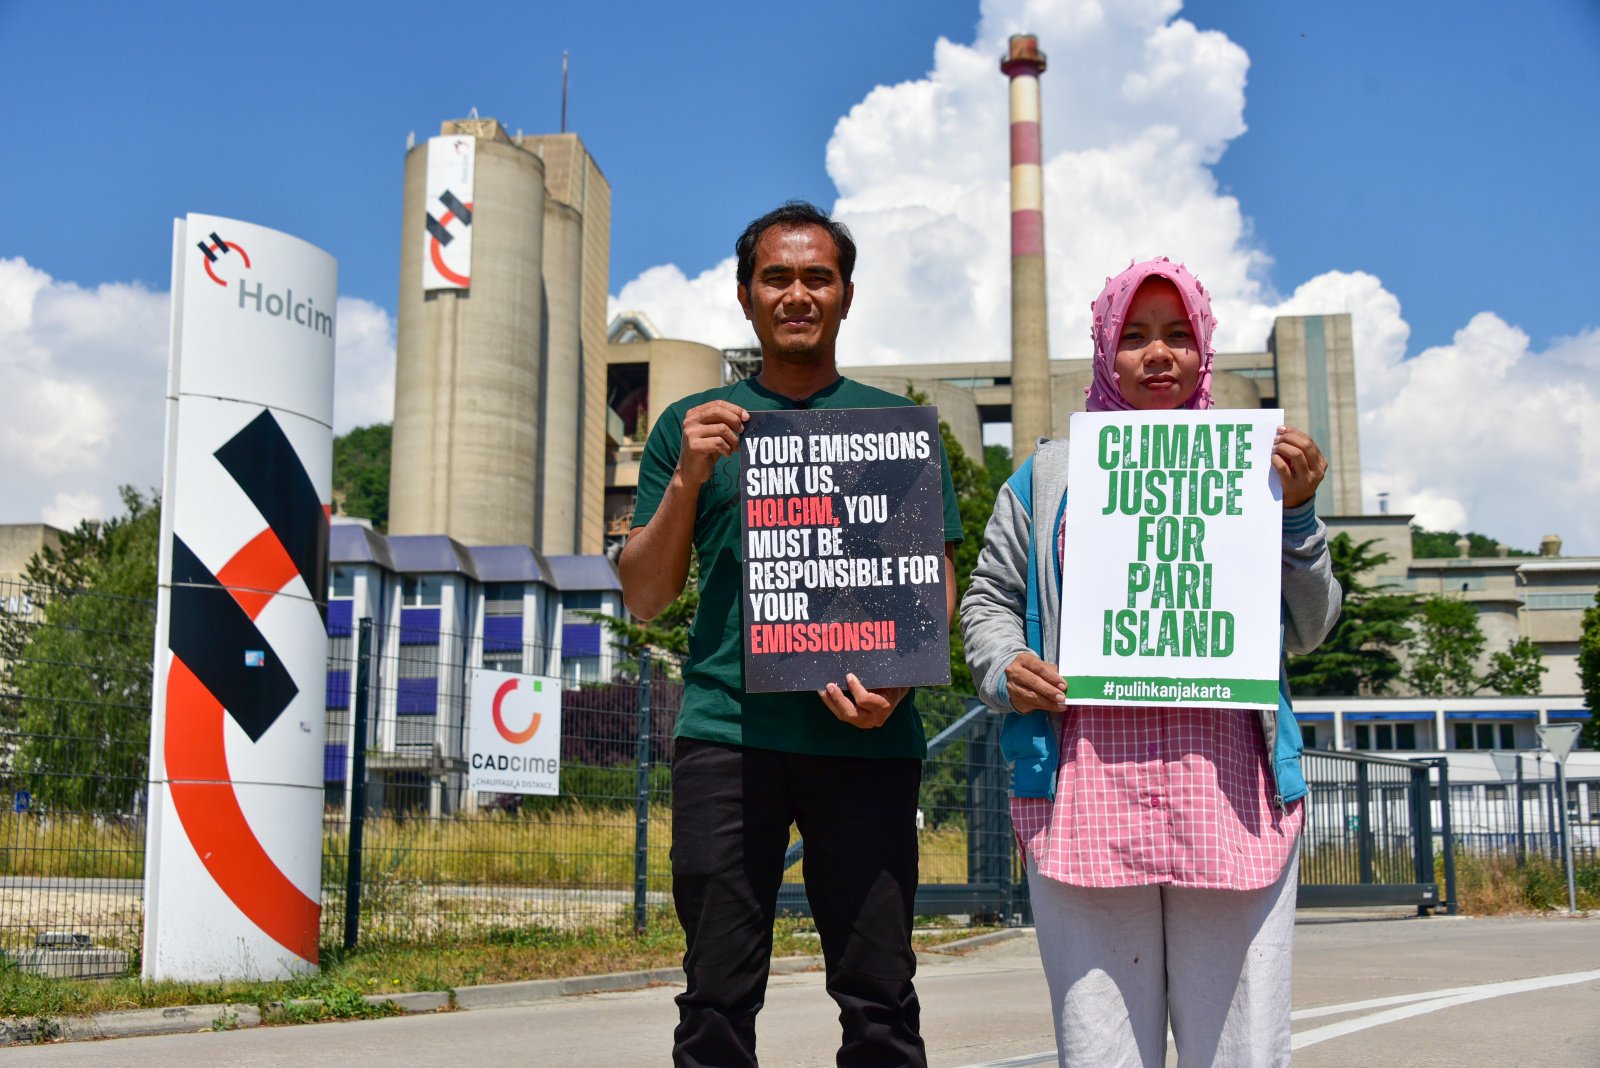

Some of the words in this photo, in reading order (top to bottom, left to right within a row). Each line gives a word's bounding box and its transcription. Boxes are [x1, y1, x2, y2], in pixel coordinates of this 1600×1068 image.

[239, 279, 333, 339] Holcim
[746, 436, 804, 465] YOUR
[809, 431, 930, 463] EMISSIONS
[1098, 424, 1253, 469] CLIMATE
[746, 466, 802, 496] SINK
[804, 465, 840, 494] US.
[1102, 470, 1244, 516] JUSTICE
[747, 496, 841, 528] HOLCIM,
[844, 495, 888, 524] YOU
[748, 529, 812, 559] MUST
[817, 528, 844, 556] BE
[1137, 516, 1205, 562] FOR
[749, 557, 893, 590] RESPONSIBLE
[898, 555, 940, 585] FOR
[1127, 562, 1213, 609] PARI
[750, 593, 810, 622] YOUR
[751, 620, 896, 654] EMISSIONS!!!
[1102, 609, 1235, 658] ISLAND
[1103, 681, 1231, 702] #pulihkanjakarta
[521, 780, 552, 789] DISTANCE
